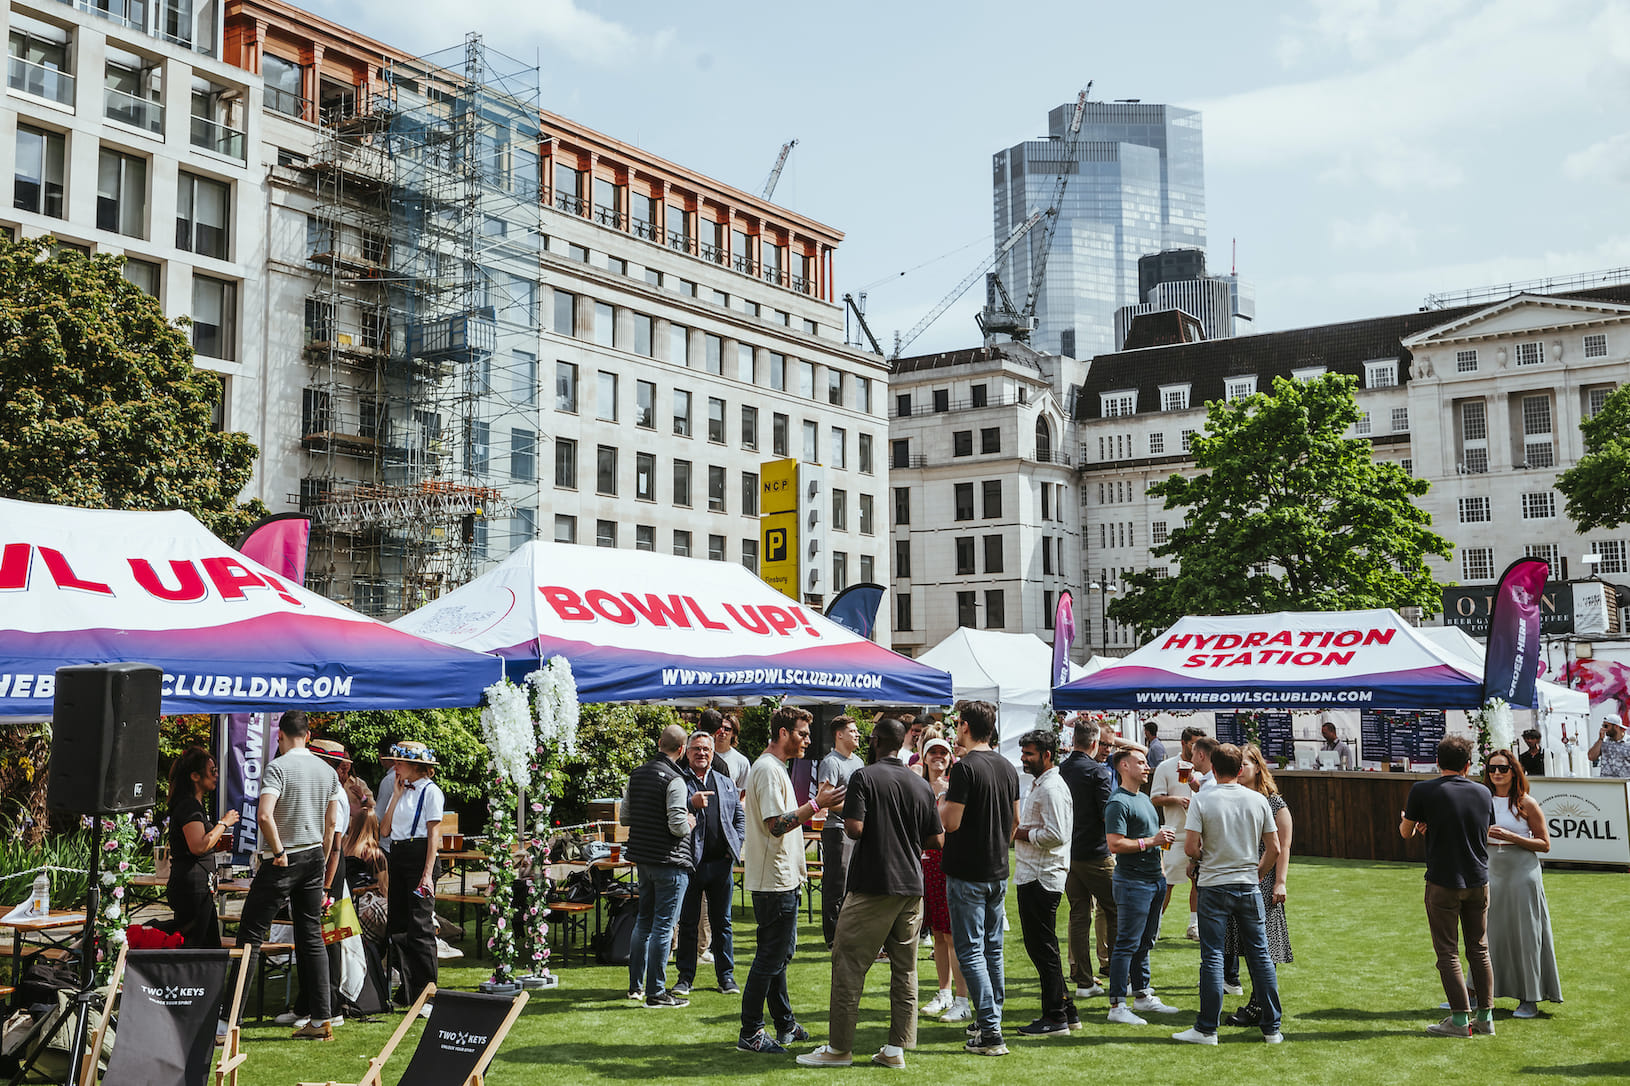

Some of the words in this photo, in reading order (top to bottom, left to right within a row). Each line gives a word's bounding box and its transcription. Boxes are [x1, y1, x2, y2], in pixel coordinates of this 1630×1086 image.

[764, 480, 788, 493] NCP
[127, 557, 305, 608] UP!
[538, 586, 732, 632] BOWL
[722, 602, 823, 639] UP!
[1161, 628, 1397, 651] HYDRATION
[1182, 650, 1357, 669] STATION
[661, 668, 883, 689] WWW.THEBOWLSCLUBLDN.COM
[1135, 691, 1373, 703] WWW.THEBOWLSCLUBLDN.COM
[237, 802, 258, 854] THE
[1548, 818, 1617, 840] SPALL
[141, 984, 164, 997] TWO
[180, 987, 205, 997] KEYS
[439, 1030, 457, 1041] TWO
[468, 1034, 488, 1045] KEYS
